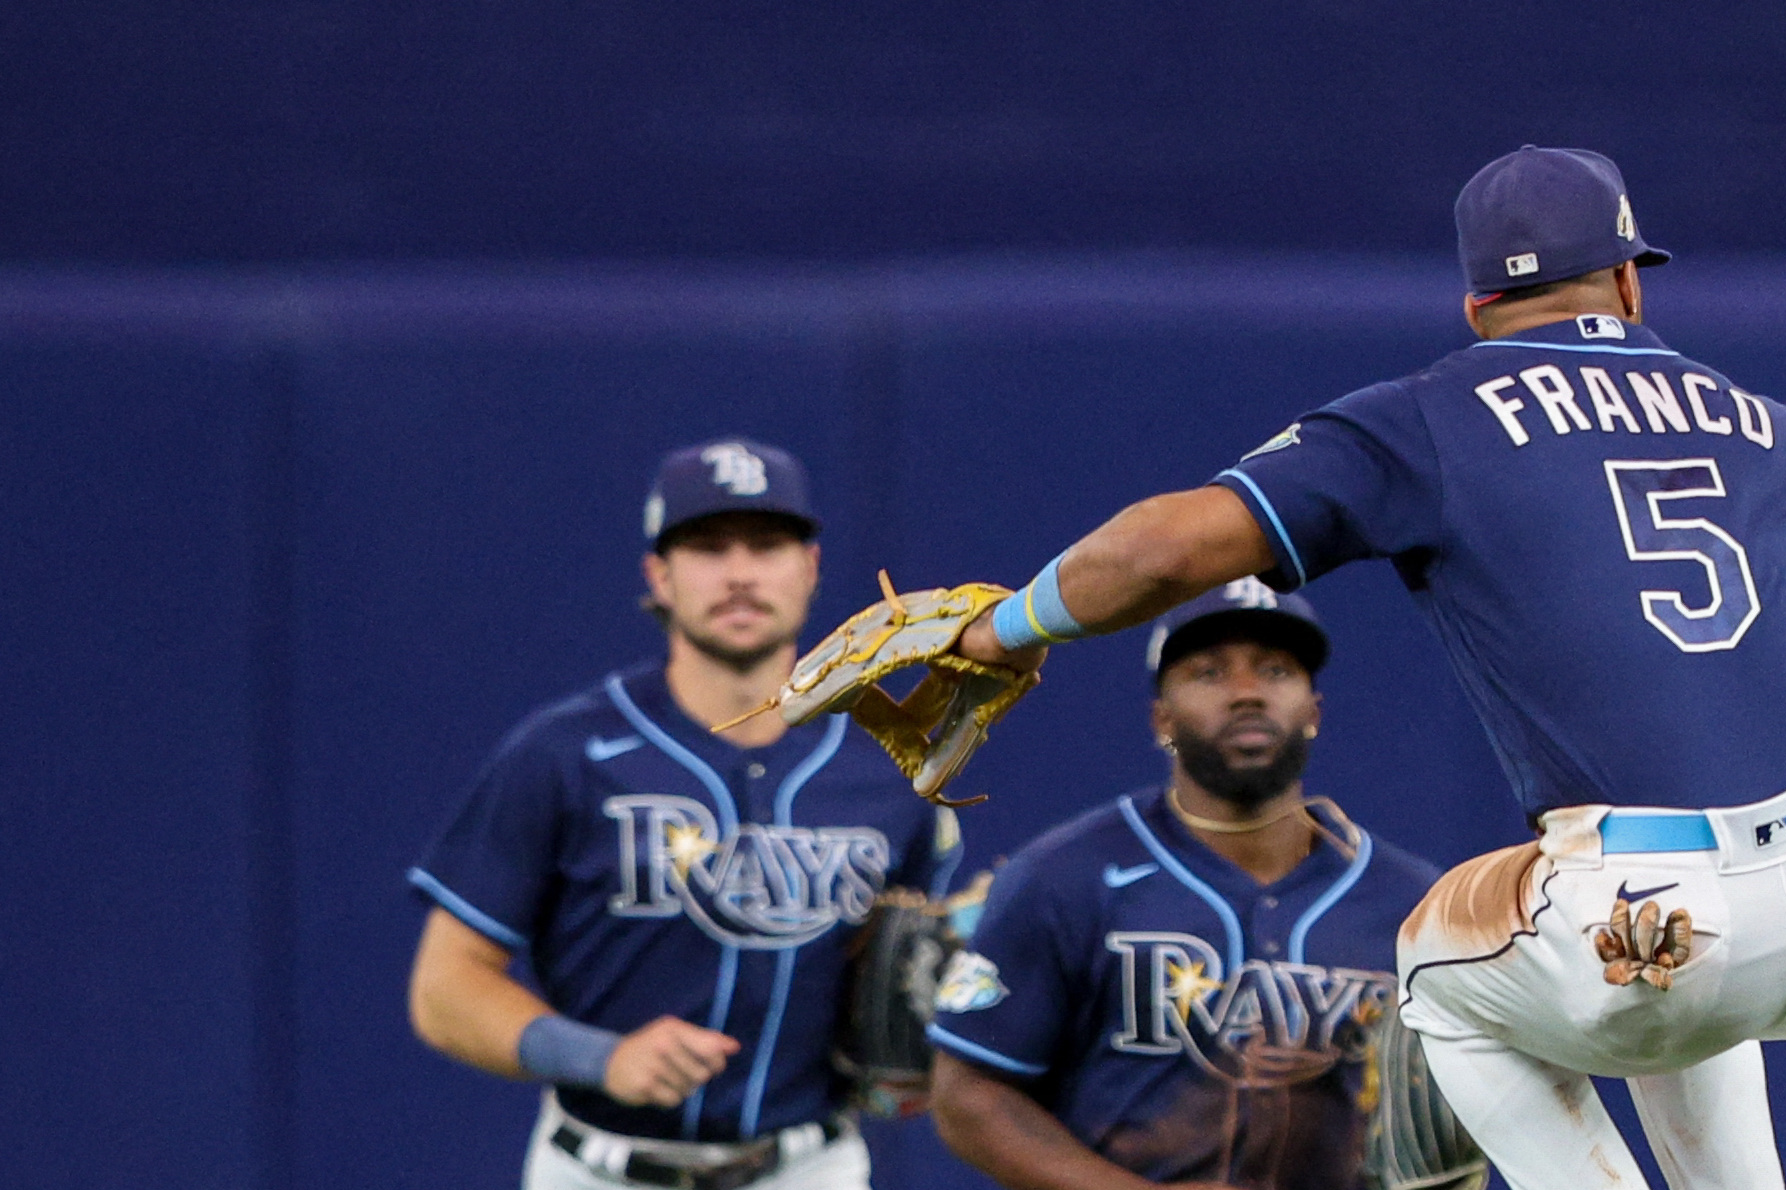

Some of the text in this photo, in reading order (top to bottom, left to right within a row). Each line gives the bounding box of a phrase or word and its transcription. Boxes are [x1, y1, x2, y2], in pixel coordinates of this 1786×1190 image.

[1474, 364, 1774, 450] FRANCO
[700, 443, 768, 496] TB
[1603, 458, 1761, 652] 5
